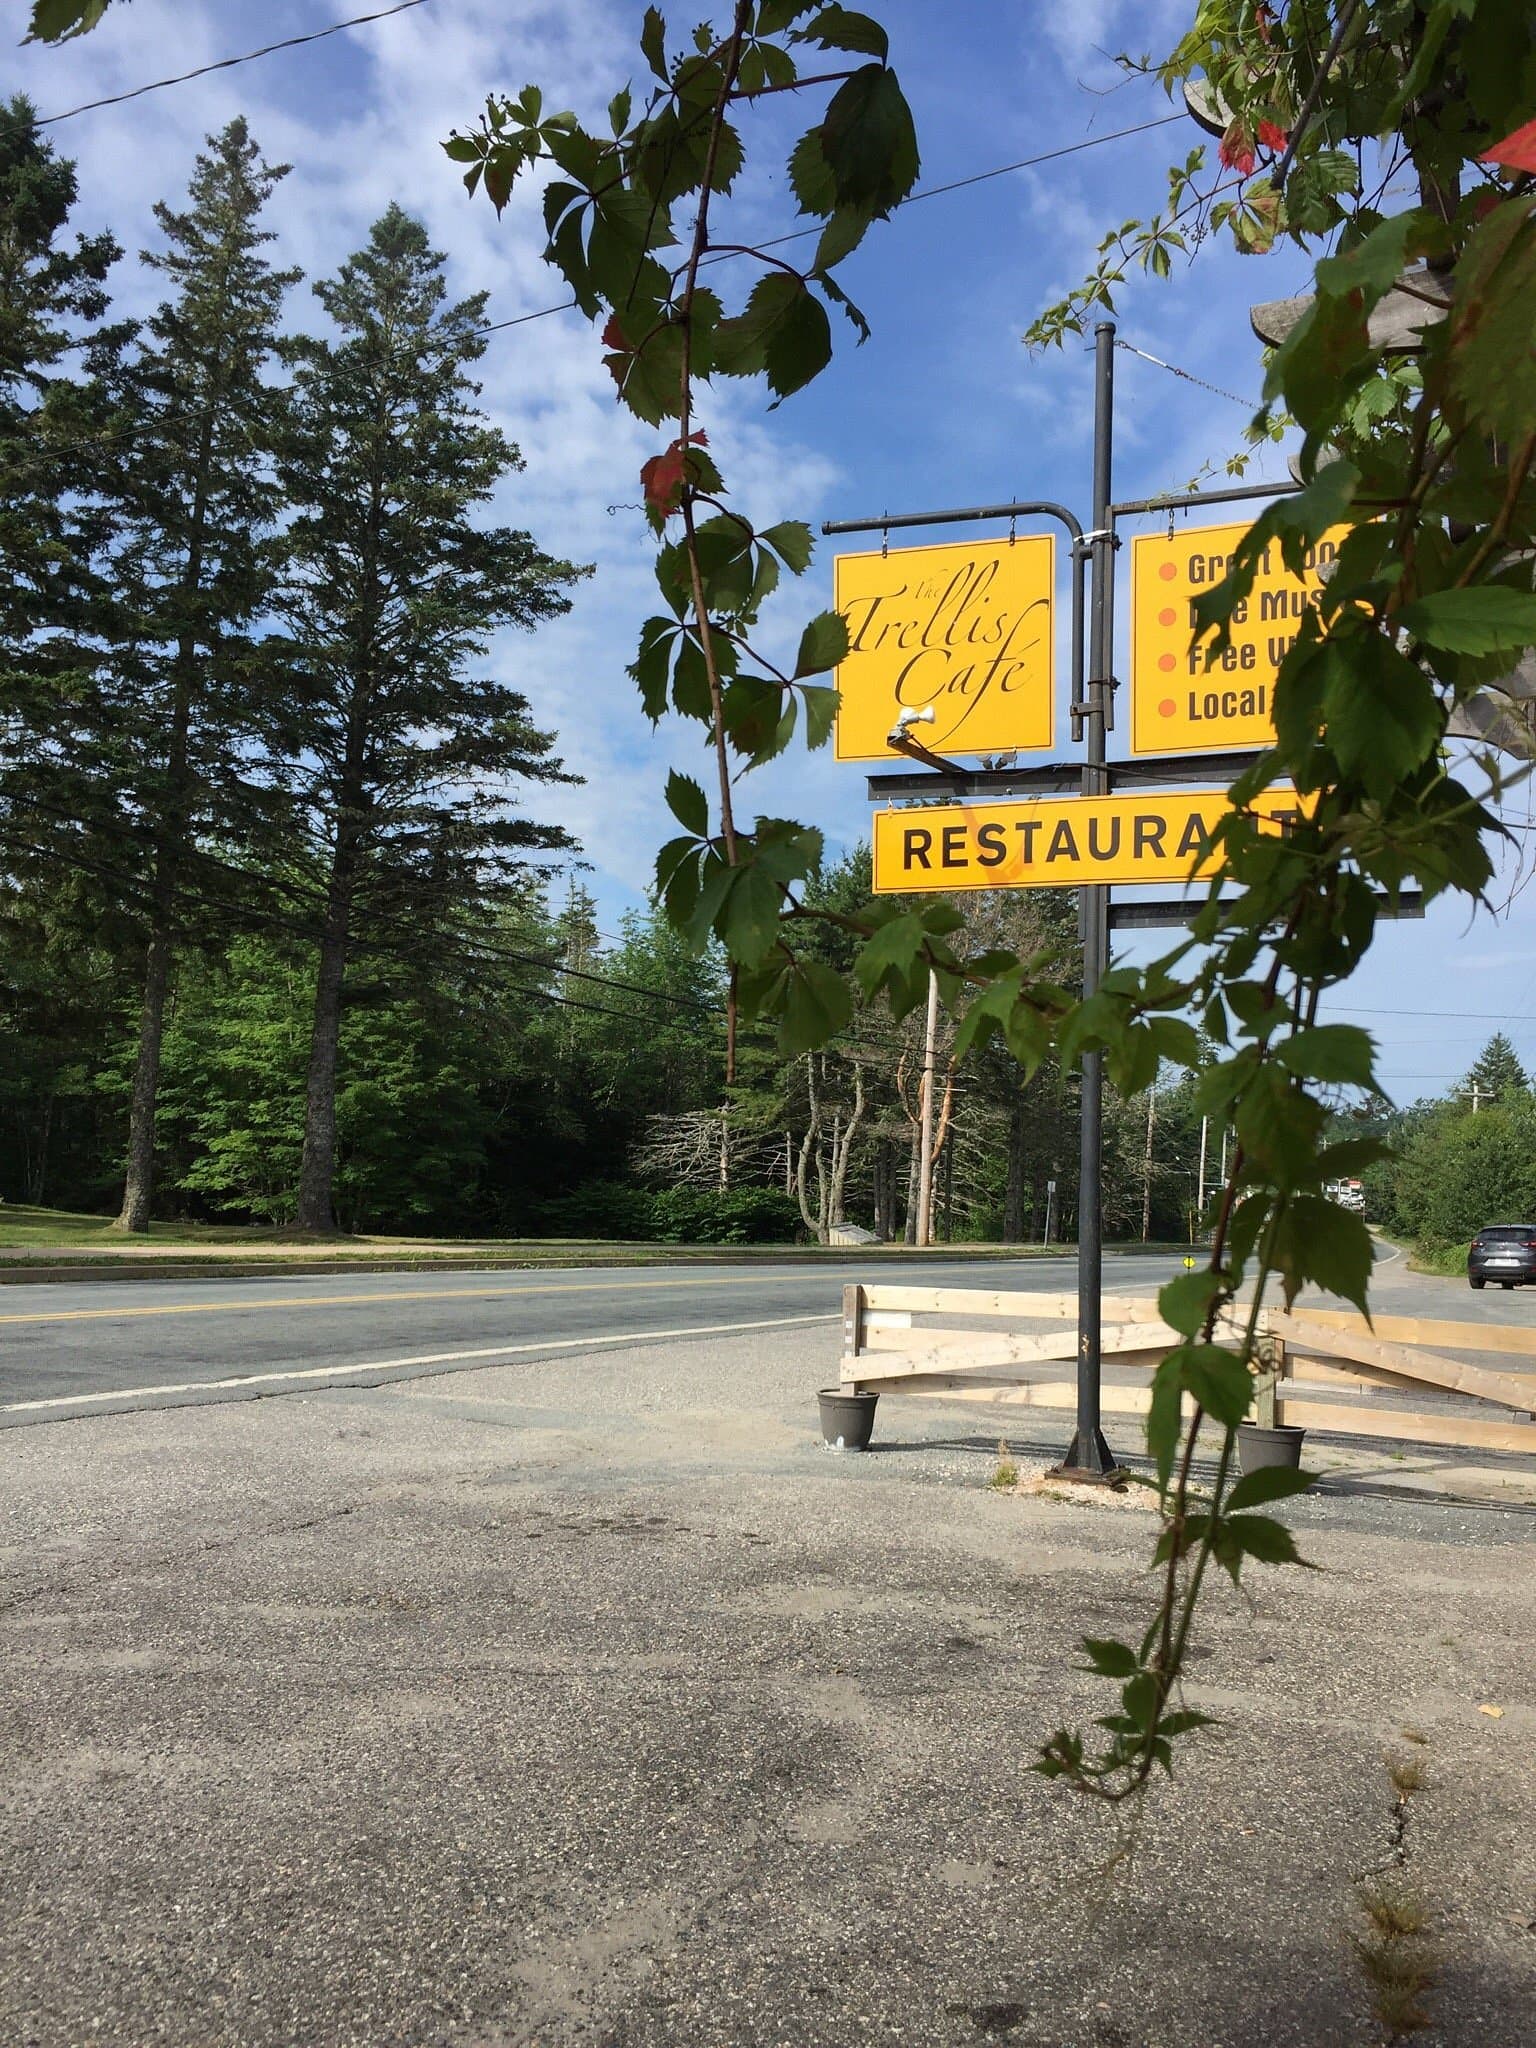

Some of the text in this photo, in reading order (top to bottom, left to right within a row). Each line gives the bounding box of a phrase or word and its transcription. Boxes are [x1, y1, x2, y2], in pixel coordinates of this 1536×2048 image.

[1188, 546, 1271, 584] Grt
[844, 559, 1009, 652] Trellis
[1261, 589, 1326, 621] Mus
[894, 598, 1050, 750] Café
[1188, 686, 1265, 721] Local
